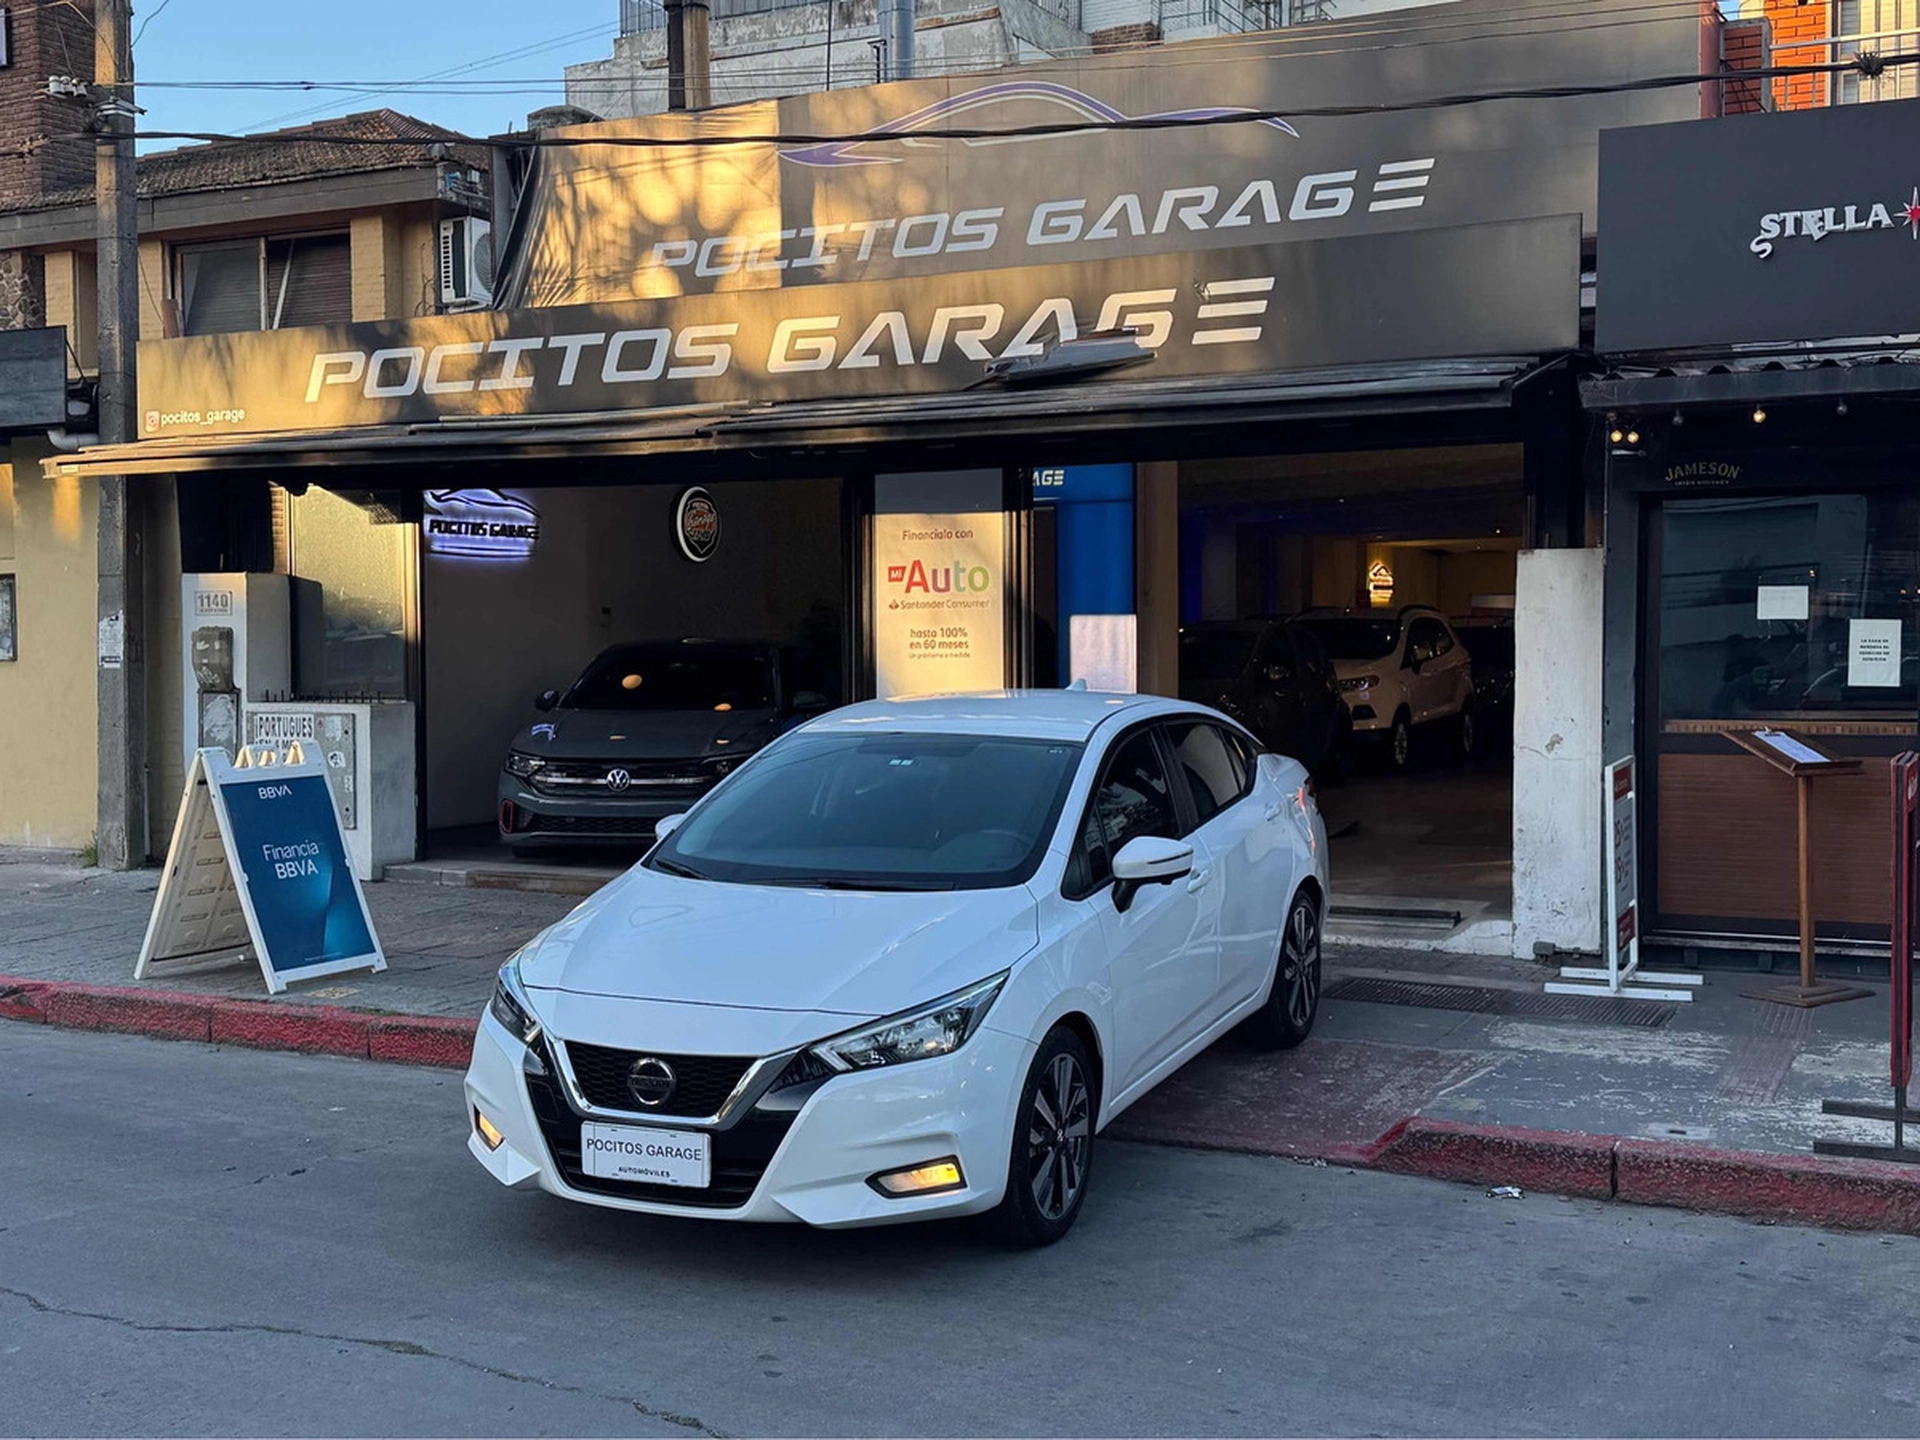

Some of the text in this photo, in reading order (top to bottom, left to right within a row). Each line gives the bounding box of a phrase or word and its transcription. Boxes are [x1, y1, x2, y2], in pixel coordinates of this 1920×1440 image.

[650, 157, 1435, 278] POCITOS GARAGE
[1750, 203, 1895, 259] STELLA
[305, 277, 1275, 402] POCITOS GARAGE
[161, 409, 245, 427] pocitos_garage
[1665, 461, 1740, 481] JAMESON
[955, 529, 974, 539] con
[904, 559, 990, 594] Auto
[198, 594, 228, 608] 1140
[900, 599, 990, 610] Santander Consumer
[910, 627, 968, 639] hasta 100%
[909, 639, 969, 650] en 60 meses
[257, 784, 292, 799] BBVA
[262, 839, 319, 861] Financia
[275, 859, 319, 880] BBVA
[586, 1138, 702, 1161] POCITOS GARAGE
